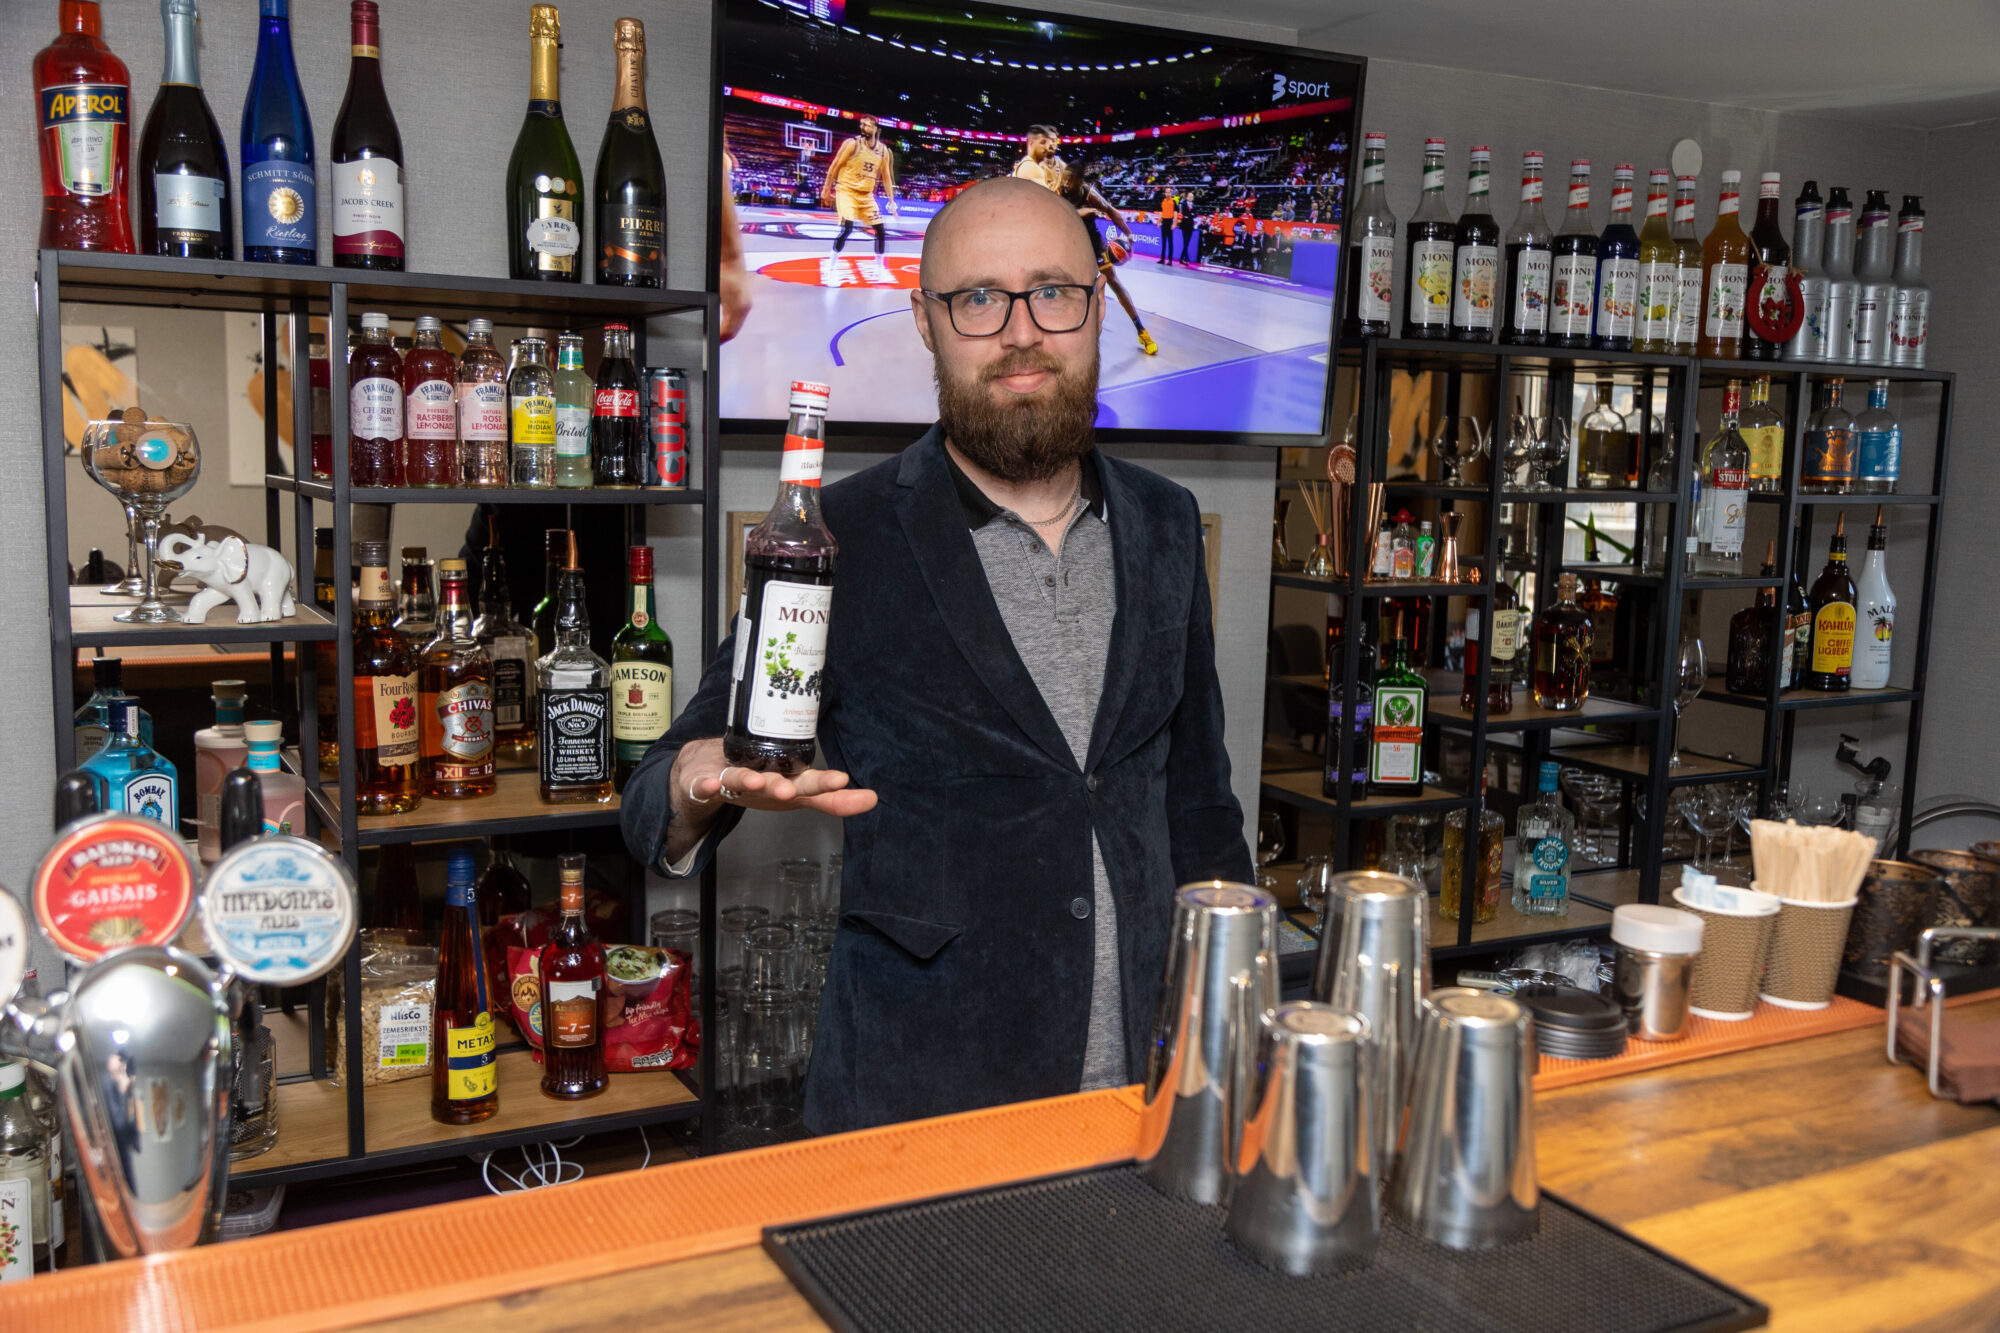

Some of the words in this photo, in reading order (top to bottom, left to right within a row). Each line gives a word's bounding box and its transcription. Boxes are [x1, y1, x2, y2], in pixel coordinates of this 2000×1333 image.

[1288, 79, 1330, 98] sport
[50, 93, 122, 119] APEROL
[247, 169, 290, 182] SCHMITT
[371, 199, 395, 208] CREEK
[266, 225, 311, 245] Riesling
[421, 383, 452, 396] FRANKLIN
[475, 385, 505, 397] FRANKLIN
[363, 407, 396, 415] CHRRY
[524, 399, 552, 410] FRANKLIN
[657, 381, 686, 483] CULT
[380, 683, 402, 697] Four
[448, 700, 492, 713] CHIVAS
[547, 702, 570, 719] JACK
[570, 698, 606, 719] DANIEL'S
[558, 736, 596, 745] Tennessee
[444, 767, 463, 778] XII
[484, 763, 493, 775] 12
[133, 785, 166, 802] BOMBAY
[1538, 840, 1564, 851] OLMECA
[70, 883, 158, 908] GAIŠAIS
[383, 1025, 428, 1034] ZEMESRIEKSTI
[570, 1023, 577, 1032] 7
